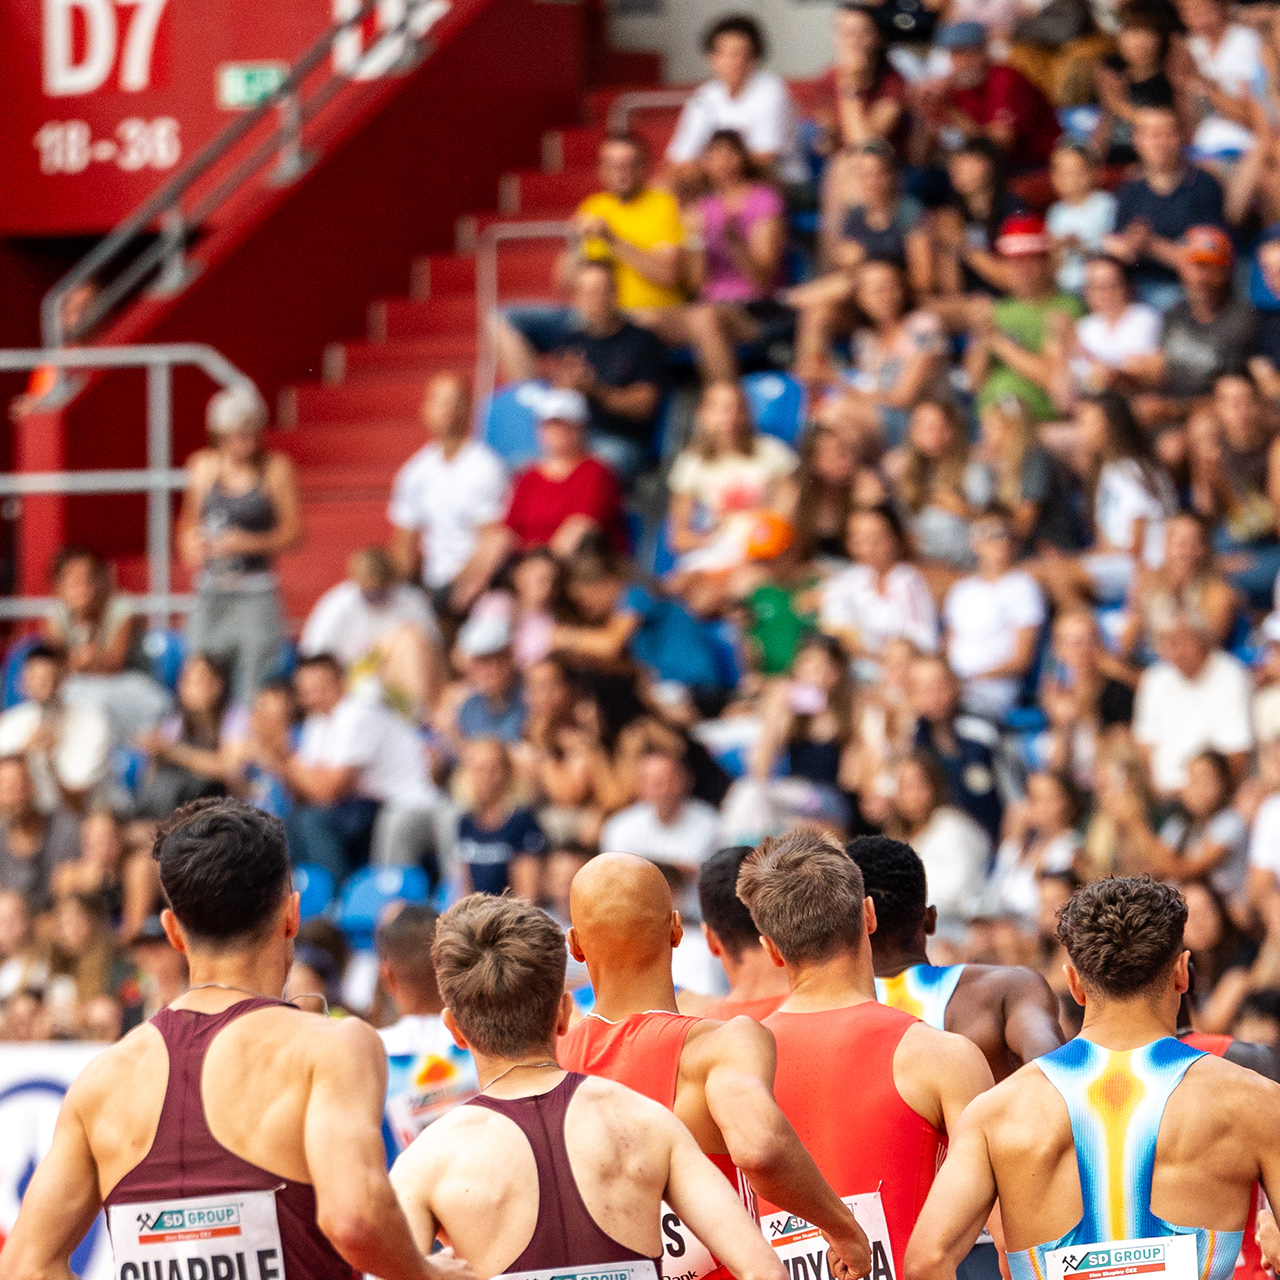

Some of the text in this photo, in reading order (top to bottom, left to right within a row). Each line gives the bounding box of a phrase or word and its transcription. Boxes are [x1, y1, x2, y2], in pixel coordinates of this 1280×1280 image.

[41, 0, 169, 97] D7
[163, 1208, 235, 1229] SD GROUP
[1088, 1248, 1161, 1266] SD GROUP
